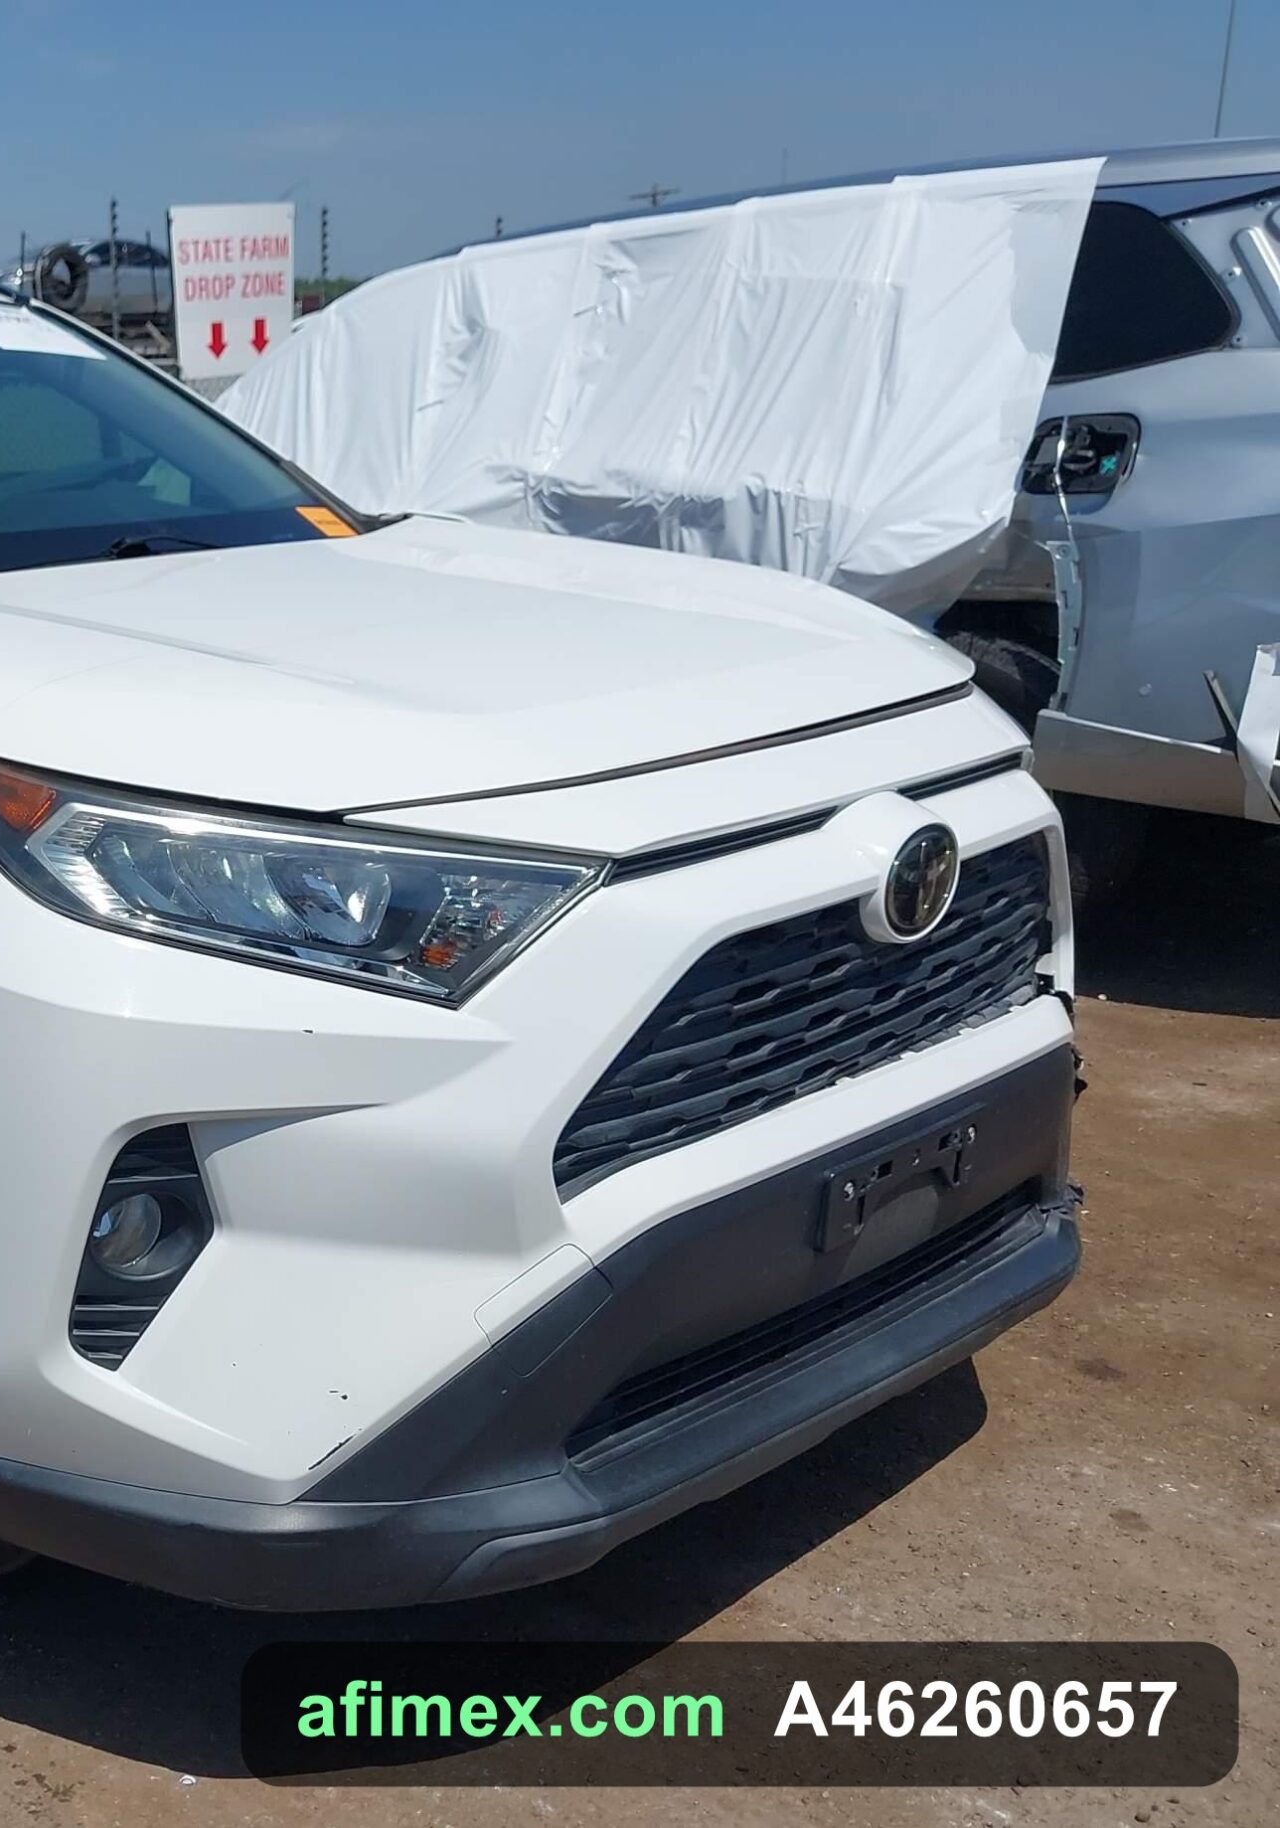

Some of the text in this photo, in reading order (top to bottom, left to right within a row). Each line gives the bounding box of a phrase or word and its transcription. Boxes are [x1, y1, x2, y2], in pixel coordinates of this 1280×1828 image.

[178, 234, 289, 265] STATE FARM
[184, 271, 285, 302] DROP ZONE
